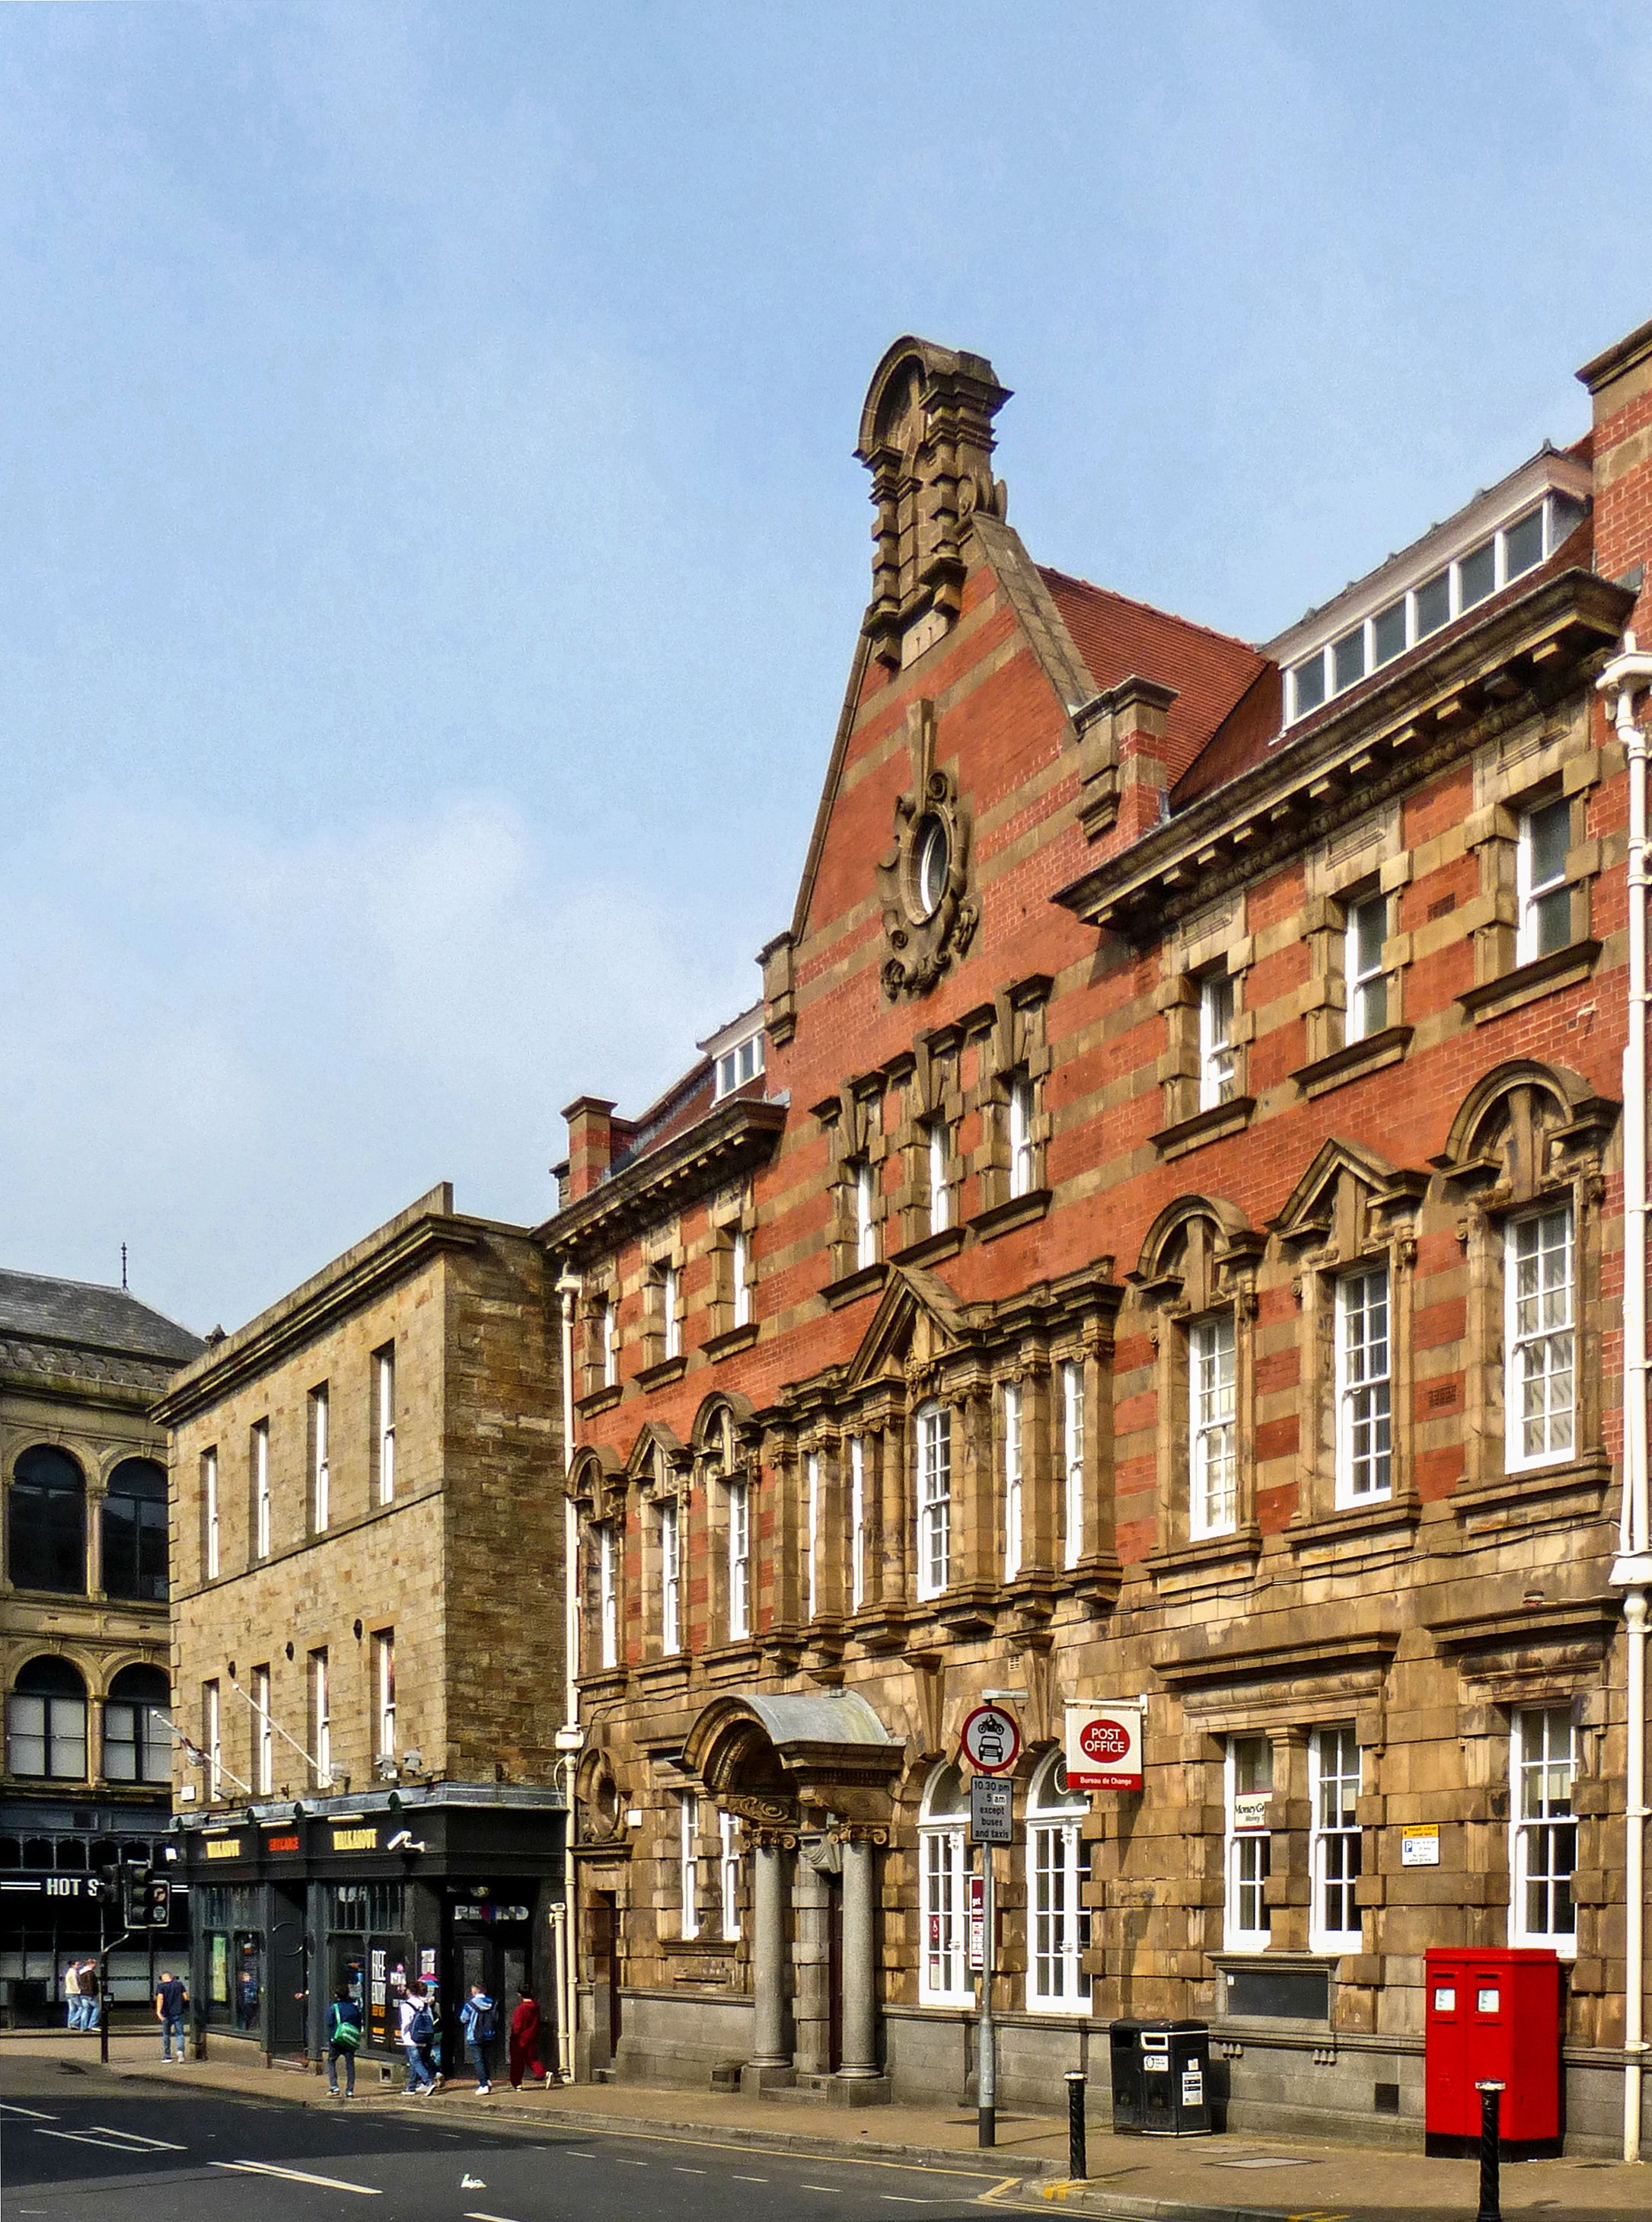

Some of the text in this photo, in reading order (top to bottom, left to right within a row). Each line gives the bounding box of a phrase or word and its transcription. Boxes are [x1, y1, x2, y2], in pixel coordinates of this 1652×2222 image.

[1092, 1728, 1121, 1740] POST
[1085, 1740, 1125, 1752] OFFICE
[1111, 1777, 1132, 1786] Change
[974, 1781, 1010, 1793] 10.30 pm
[987, 1793, 992, 1802] 5
[980, 1806, 1005, 1815] except
[981, 1817, 1003, 1827] buses
[975, 1829, 1009, 1838] and taxis
[46, 1878, 81, 1896] HOT
